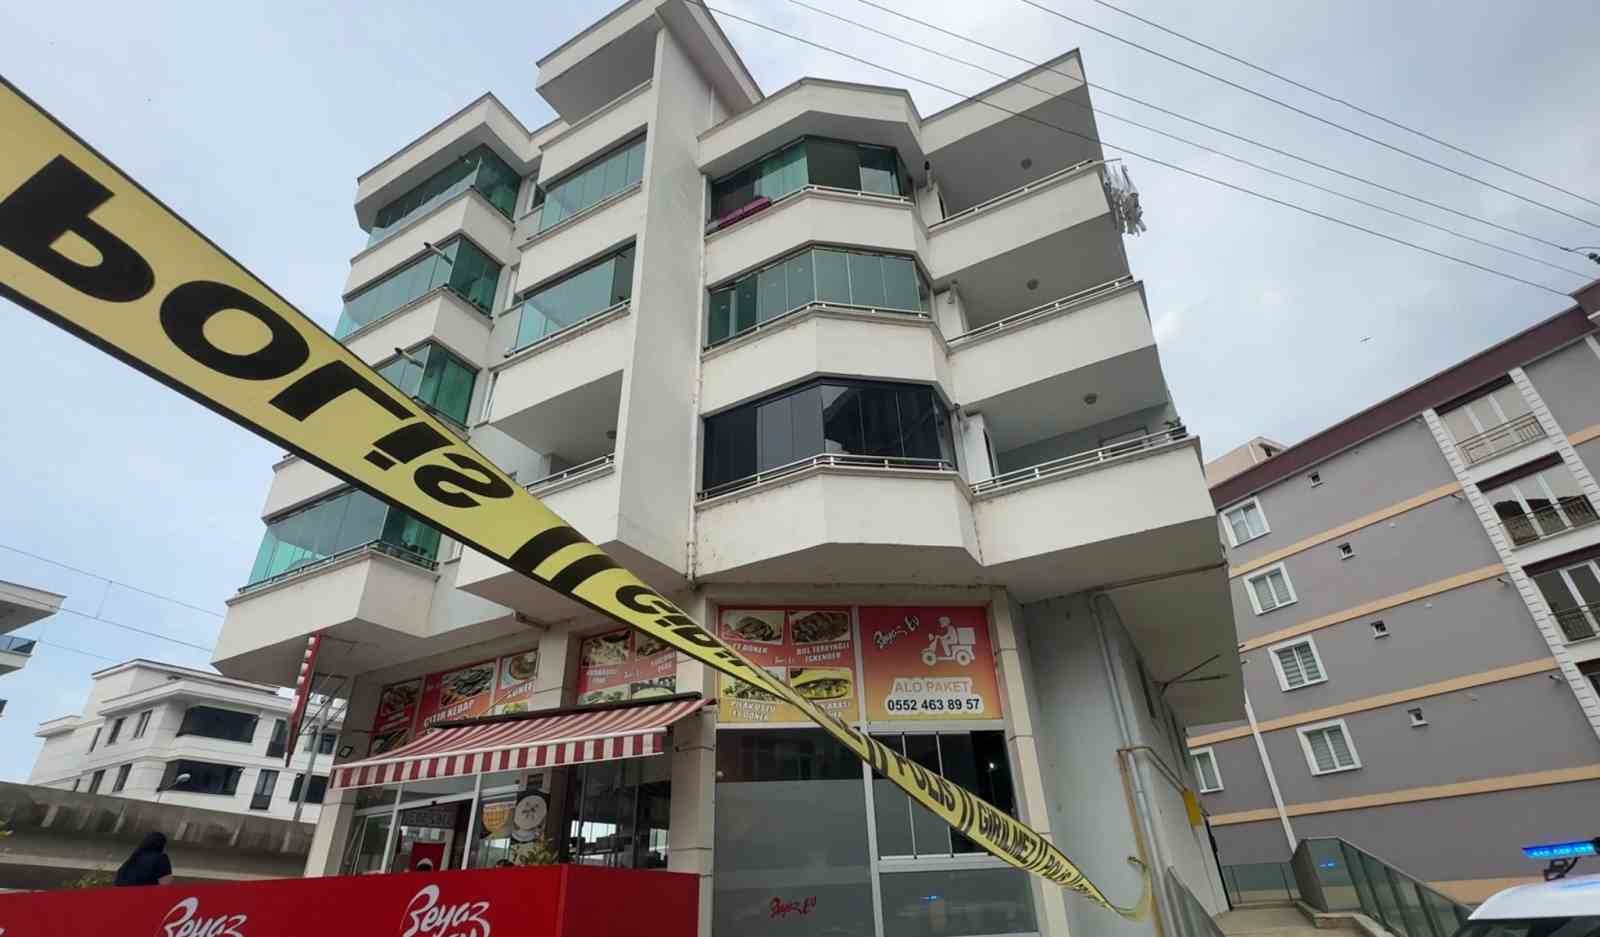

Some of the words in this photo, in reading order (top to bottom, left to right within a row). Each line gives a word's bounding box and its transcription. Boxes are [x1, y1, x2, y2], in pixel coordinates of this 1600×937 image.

[894, 681, 922, 693] ALO
[927, 680, 969, 693] PAKET
[887, 699, 918, 711] 0552
[921, 699, 944, 711] 463
[947, 699, 962, 710] 89
[966, 698, 981, 711] 57
